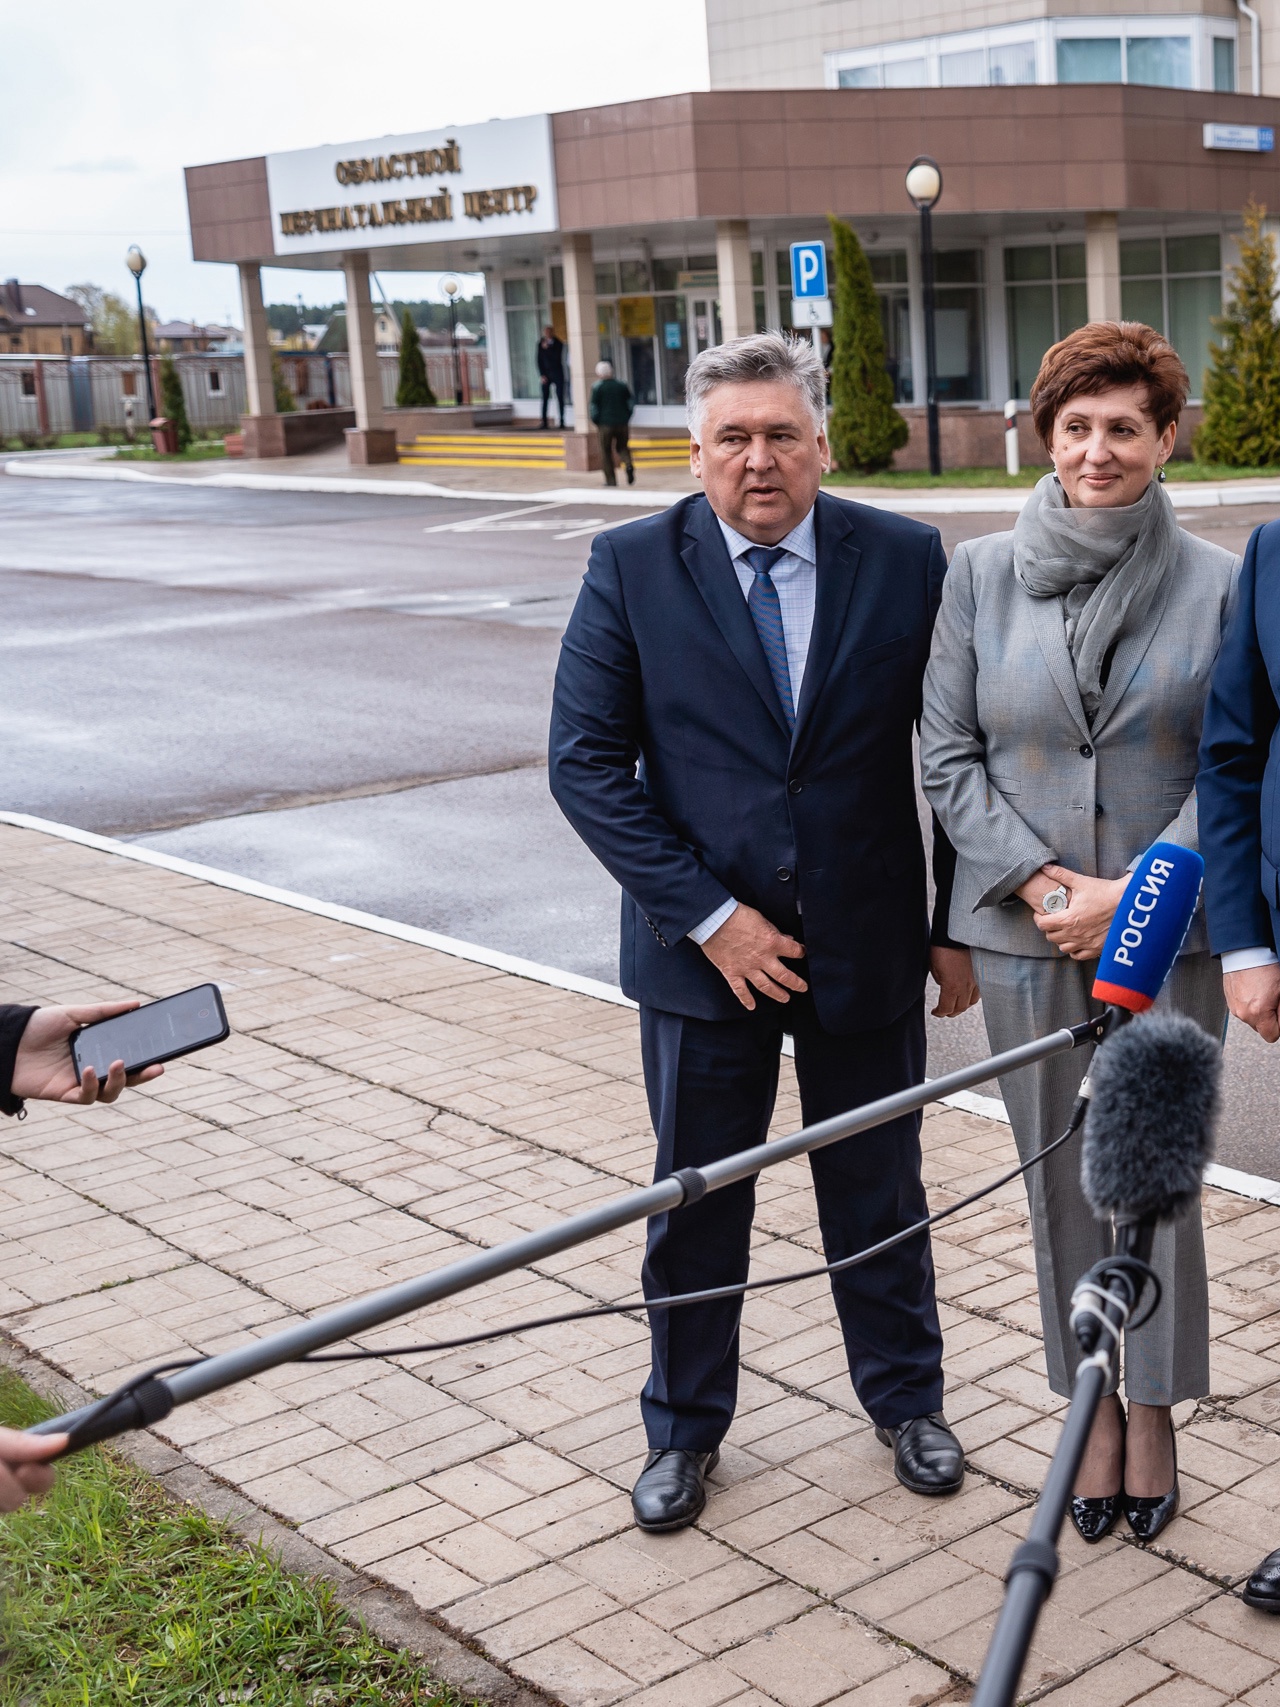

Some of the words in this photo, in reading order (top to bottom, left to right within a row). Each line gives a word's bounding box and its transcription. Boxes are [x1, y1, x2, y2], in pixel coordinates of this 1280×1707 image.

[335, 138, 461, 186] ОБЛАСТНОЙ
[280, 187, 453, 236] ПЕРИНАТАЛЬНЫЙ
[462, 185, 538, 221] ЦЕНТР
[798, 249, 819, 294] P
[1113, 858, 1175, 967] РОССИЯ
